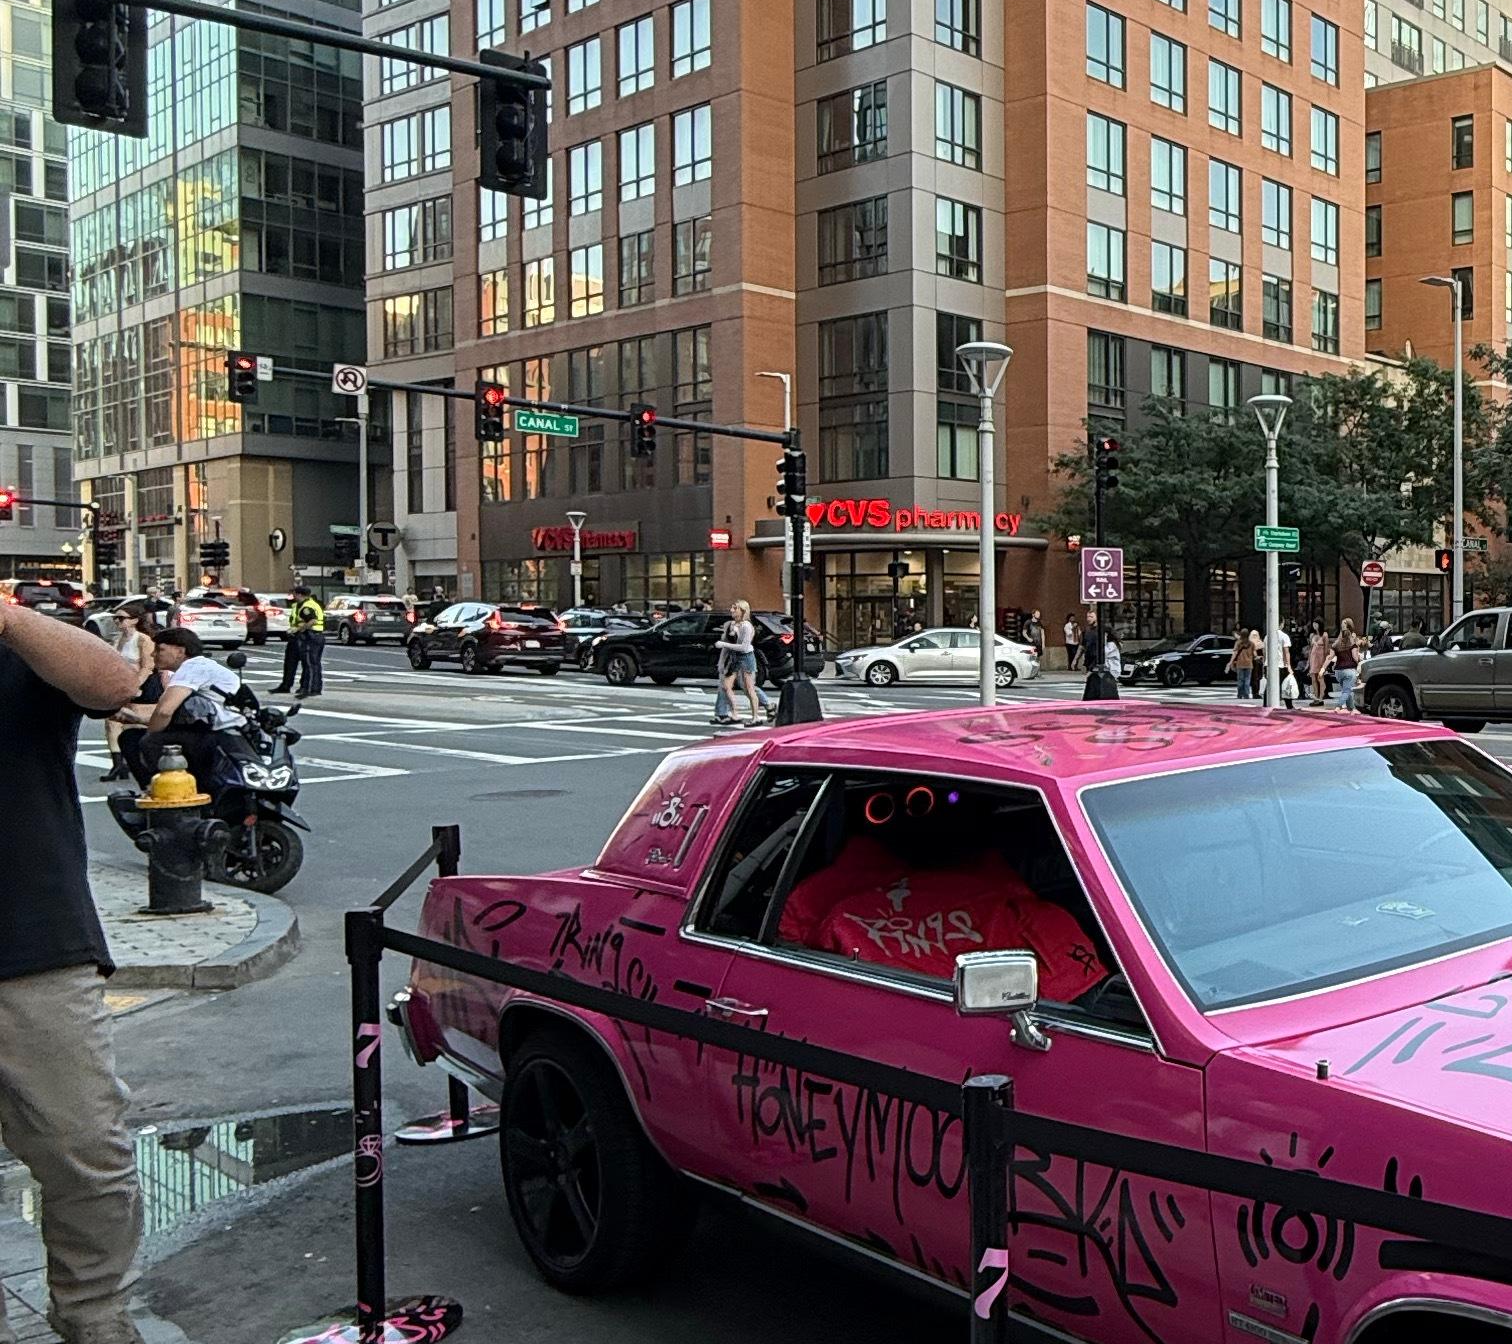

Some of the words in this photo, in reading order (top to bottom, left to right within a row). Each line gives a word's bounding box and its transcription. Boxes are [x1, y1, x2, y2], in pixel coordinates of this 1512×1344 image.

[519, 416, 561, 431] CANAL
[827, 499, 892, 528] CVS
[895, 504, 1022, 536] pharmcy
[355, 1022, 382, 1069] 7
[974, 1247, 1009, 1320] 7
